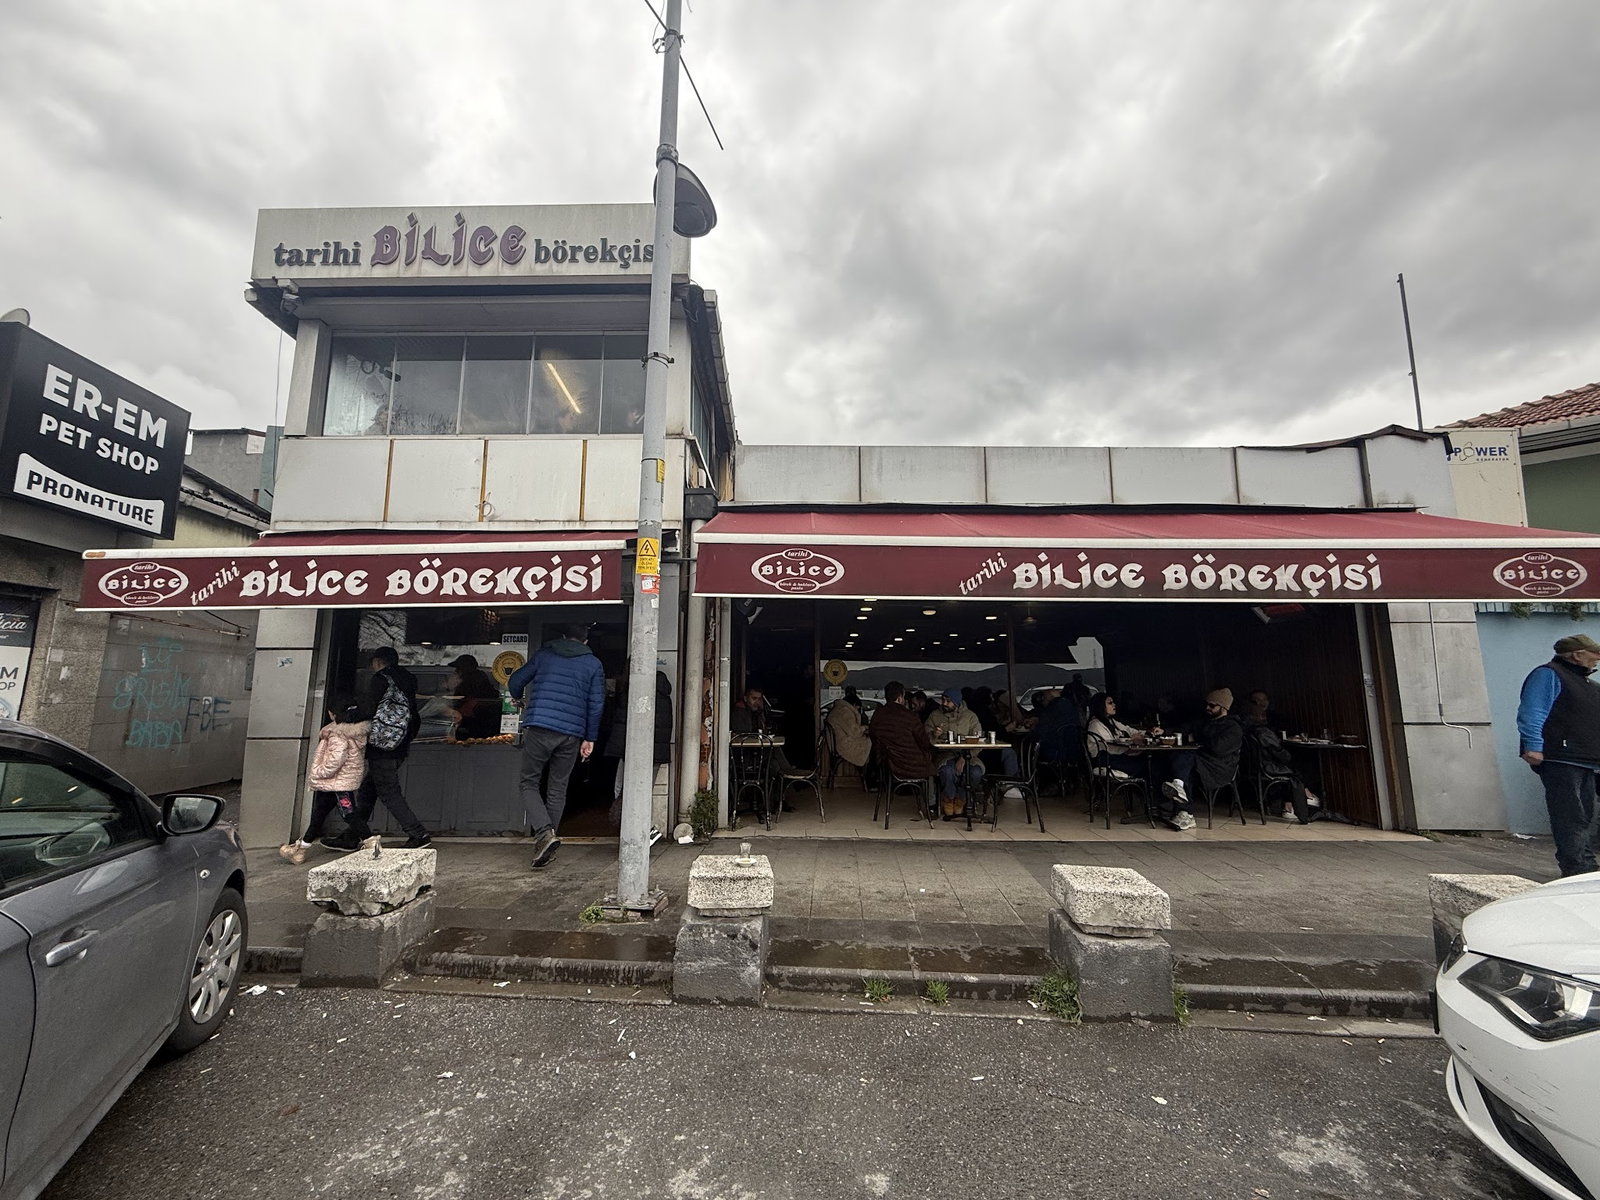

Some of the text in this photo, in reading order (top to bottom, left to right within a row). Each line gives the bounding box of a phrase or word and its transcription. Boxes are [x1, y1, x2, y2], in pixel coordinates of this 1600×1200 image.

[273, 240, 361, 267] tarihi
[534, 237, 654, 269] börekçis
[43, 363, 167, 449] ER-EM
[39, 413, 159, 475] PET SHOP
[27, 469, 154, 526] PRONATURE
[190, 554, 603, 606] tarihi BİLİCE BÖREKÇİSİ
[958, 551, 1383, 598] tarihi BİLİCE BÖREKÇİSİ
[502, 635, 528, 643] SETCARD
